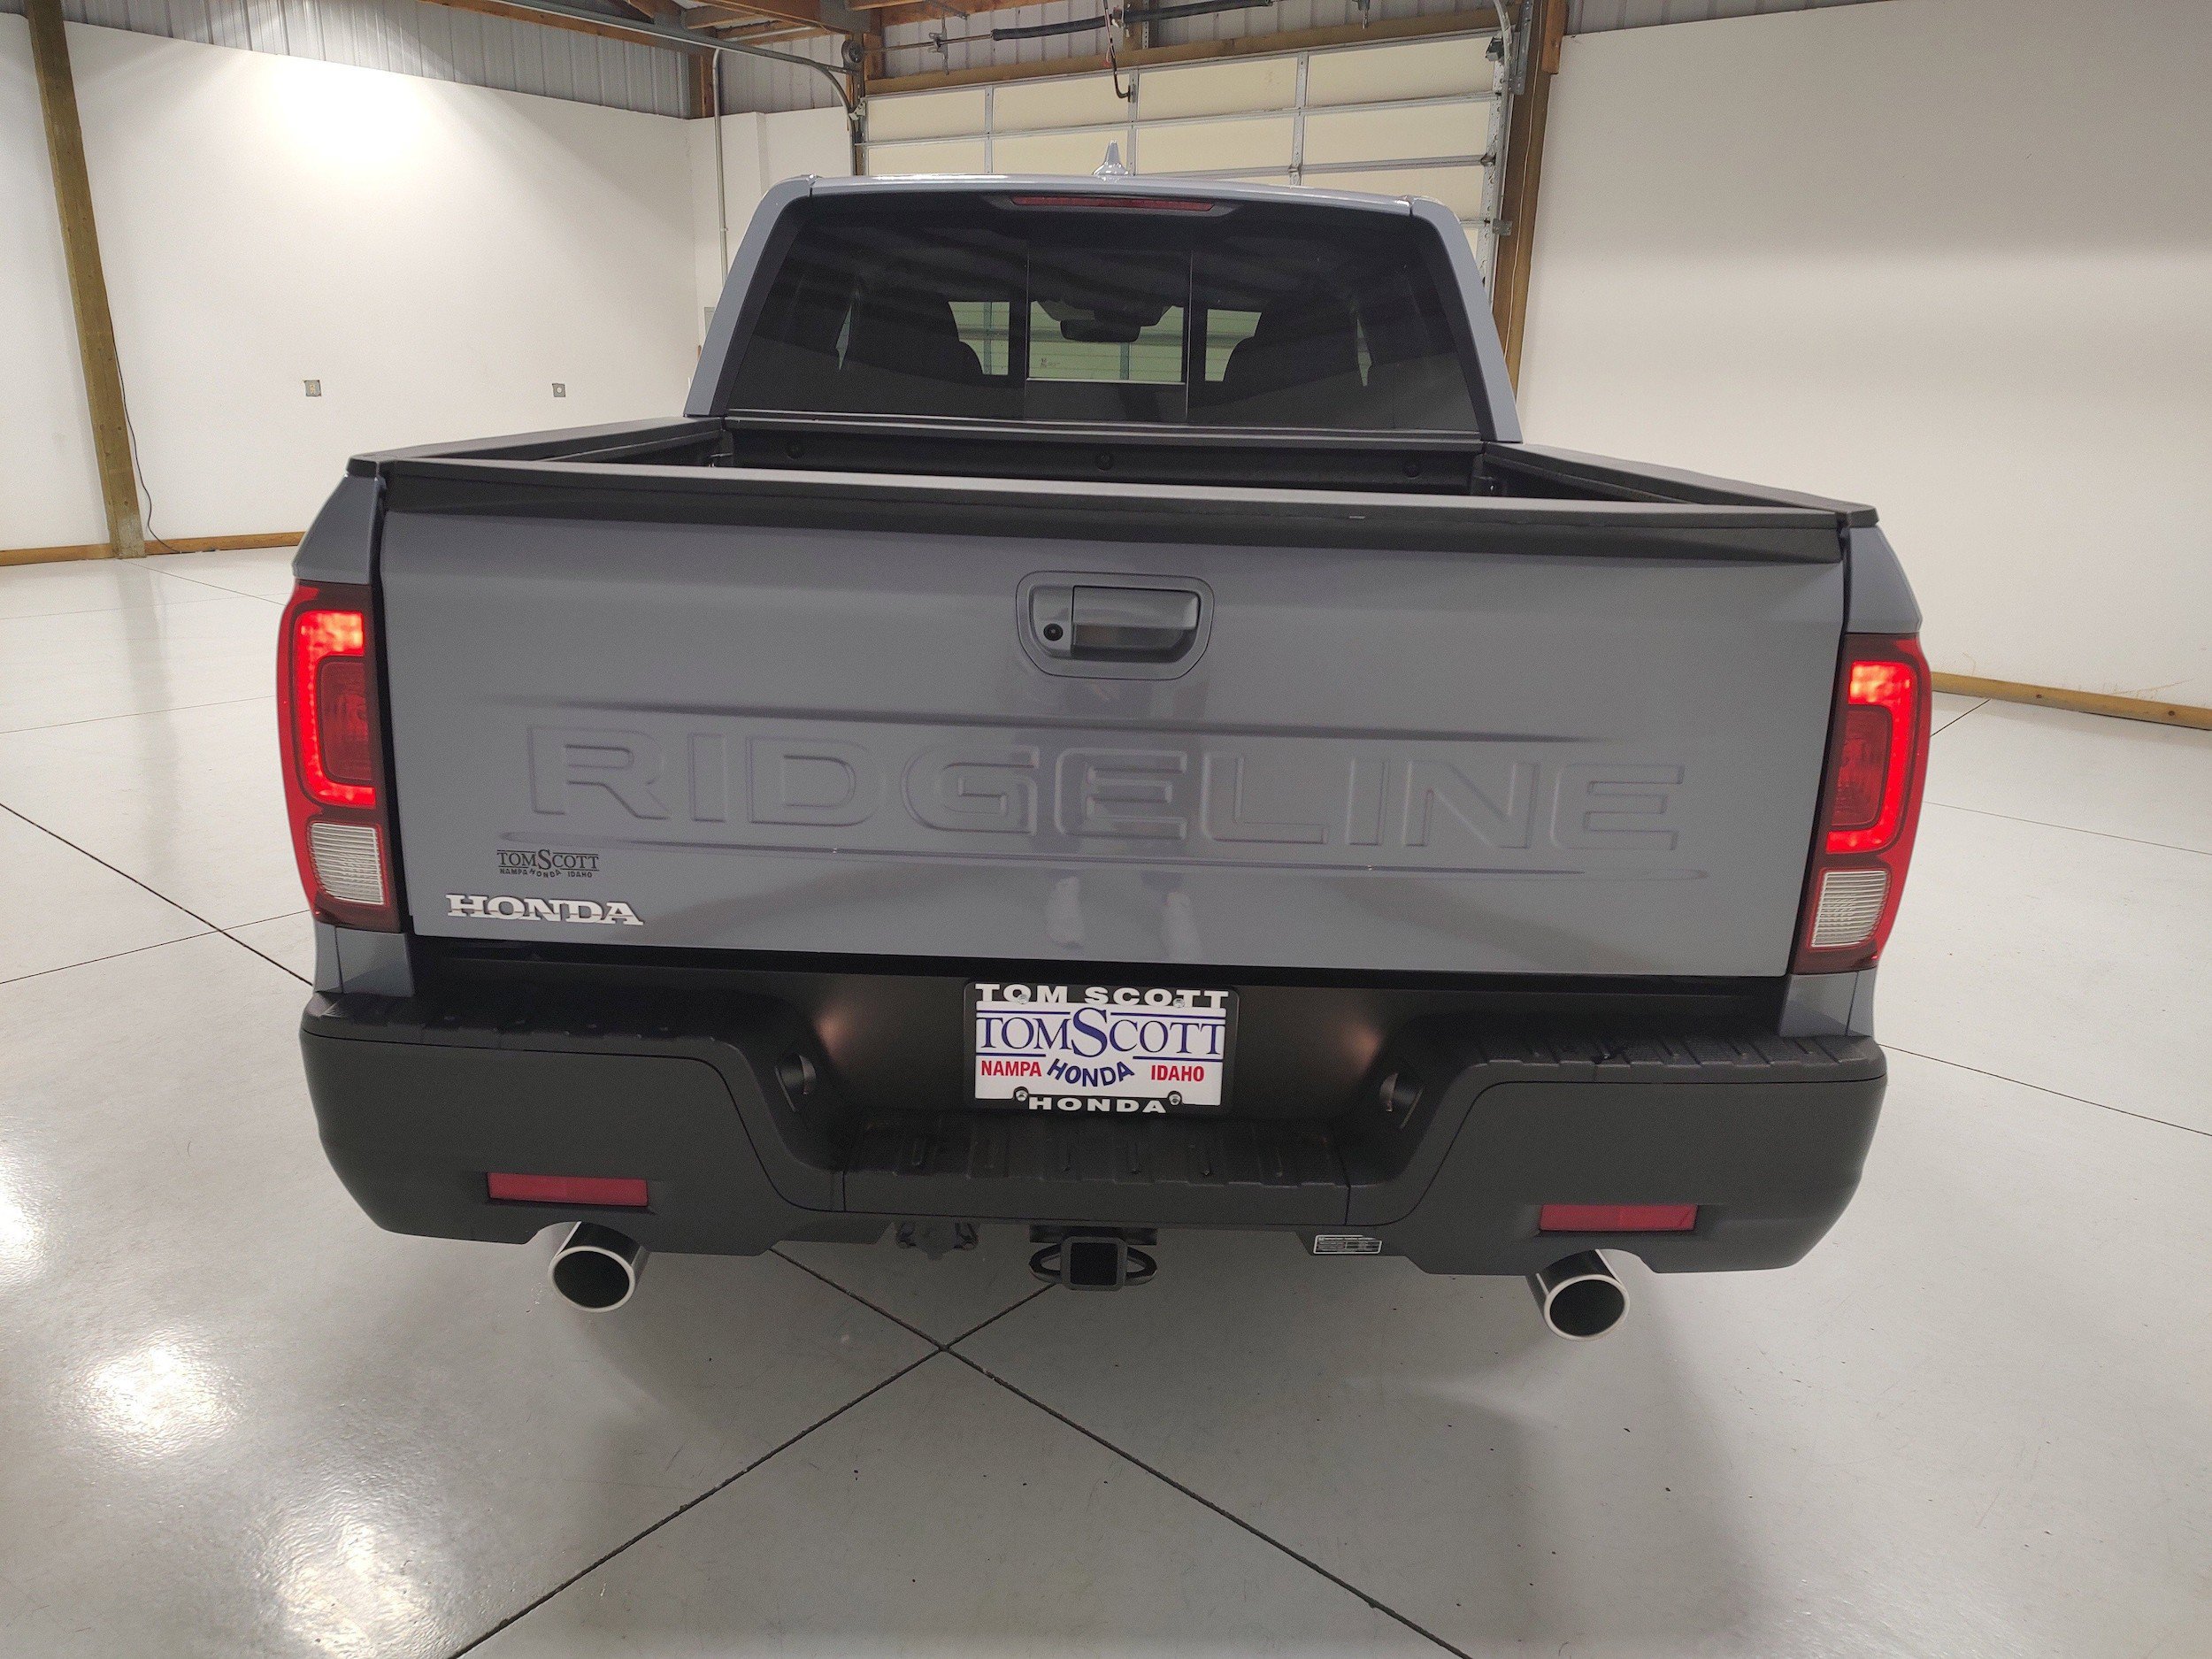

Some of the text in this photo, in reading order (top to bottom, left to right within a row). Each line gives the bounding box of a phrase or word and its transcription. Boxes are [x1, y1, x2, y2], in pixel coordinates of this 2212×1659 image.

[527, 726, 1686, 851] RIDGELINE
[530, 868, 562, 878] HONDA
[445, 894, 644, 926] HONDA
[975, 983, 1229, 1009] TOM SCOTT
[980, 1058, 1205, 1087] NAMPA HONDA IDAHO
[1028, 1096, 1167, 1114] HONDA
